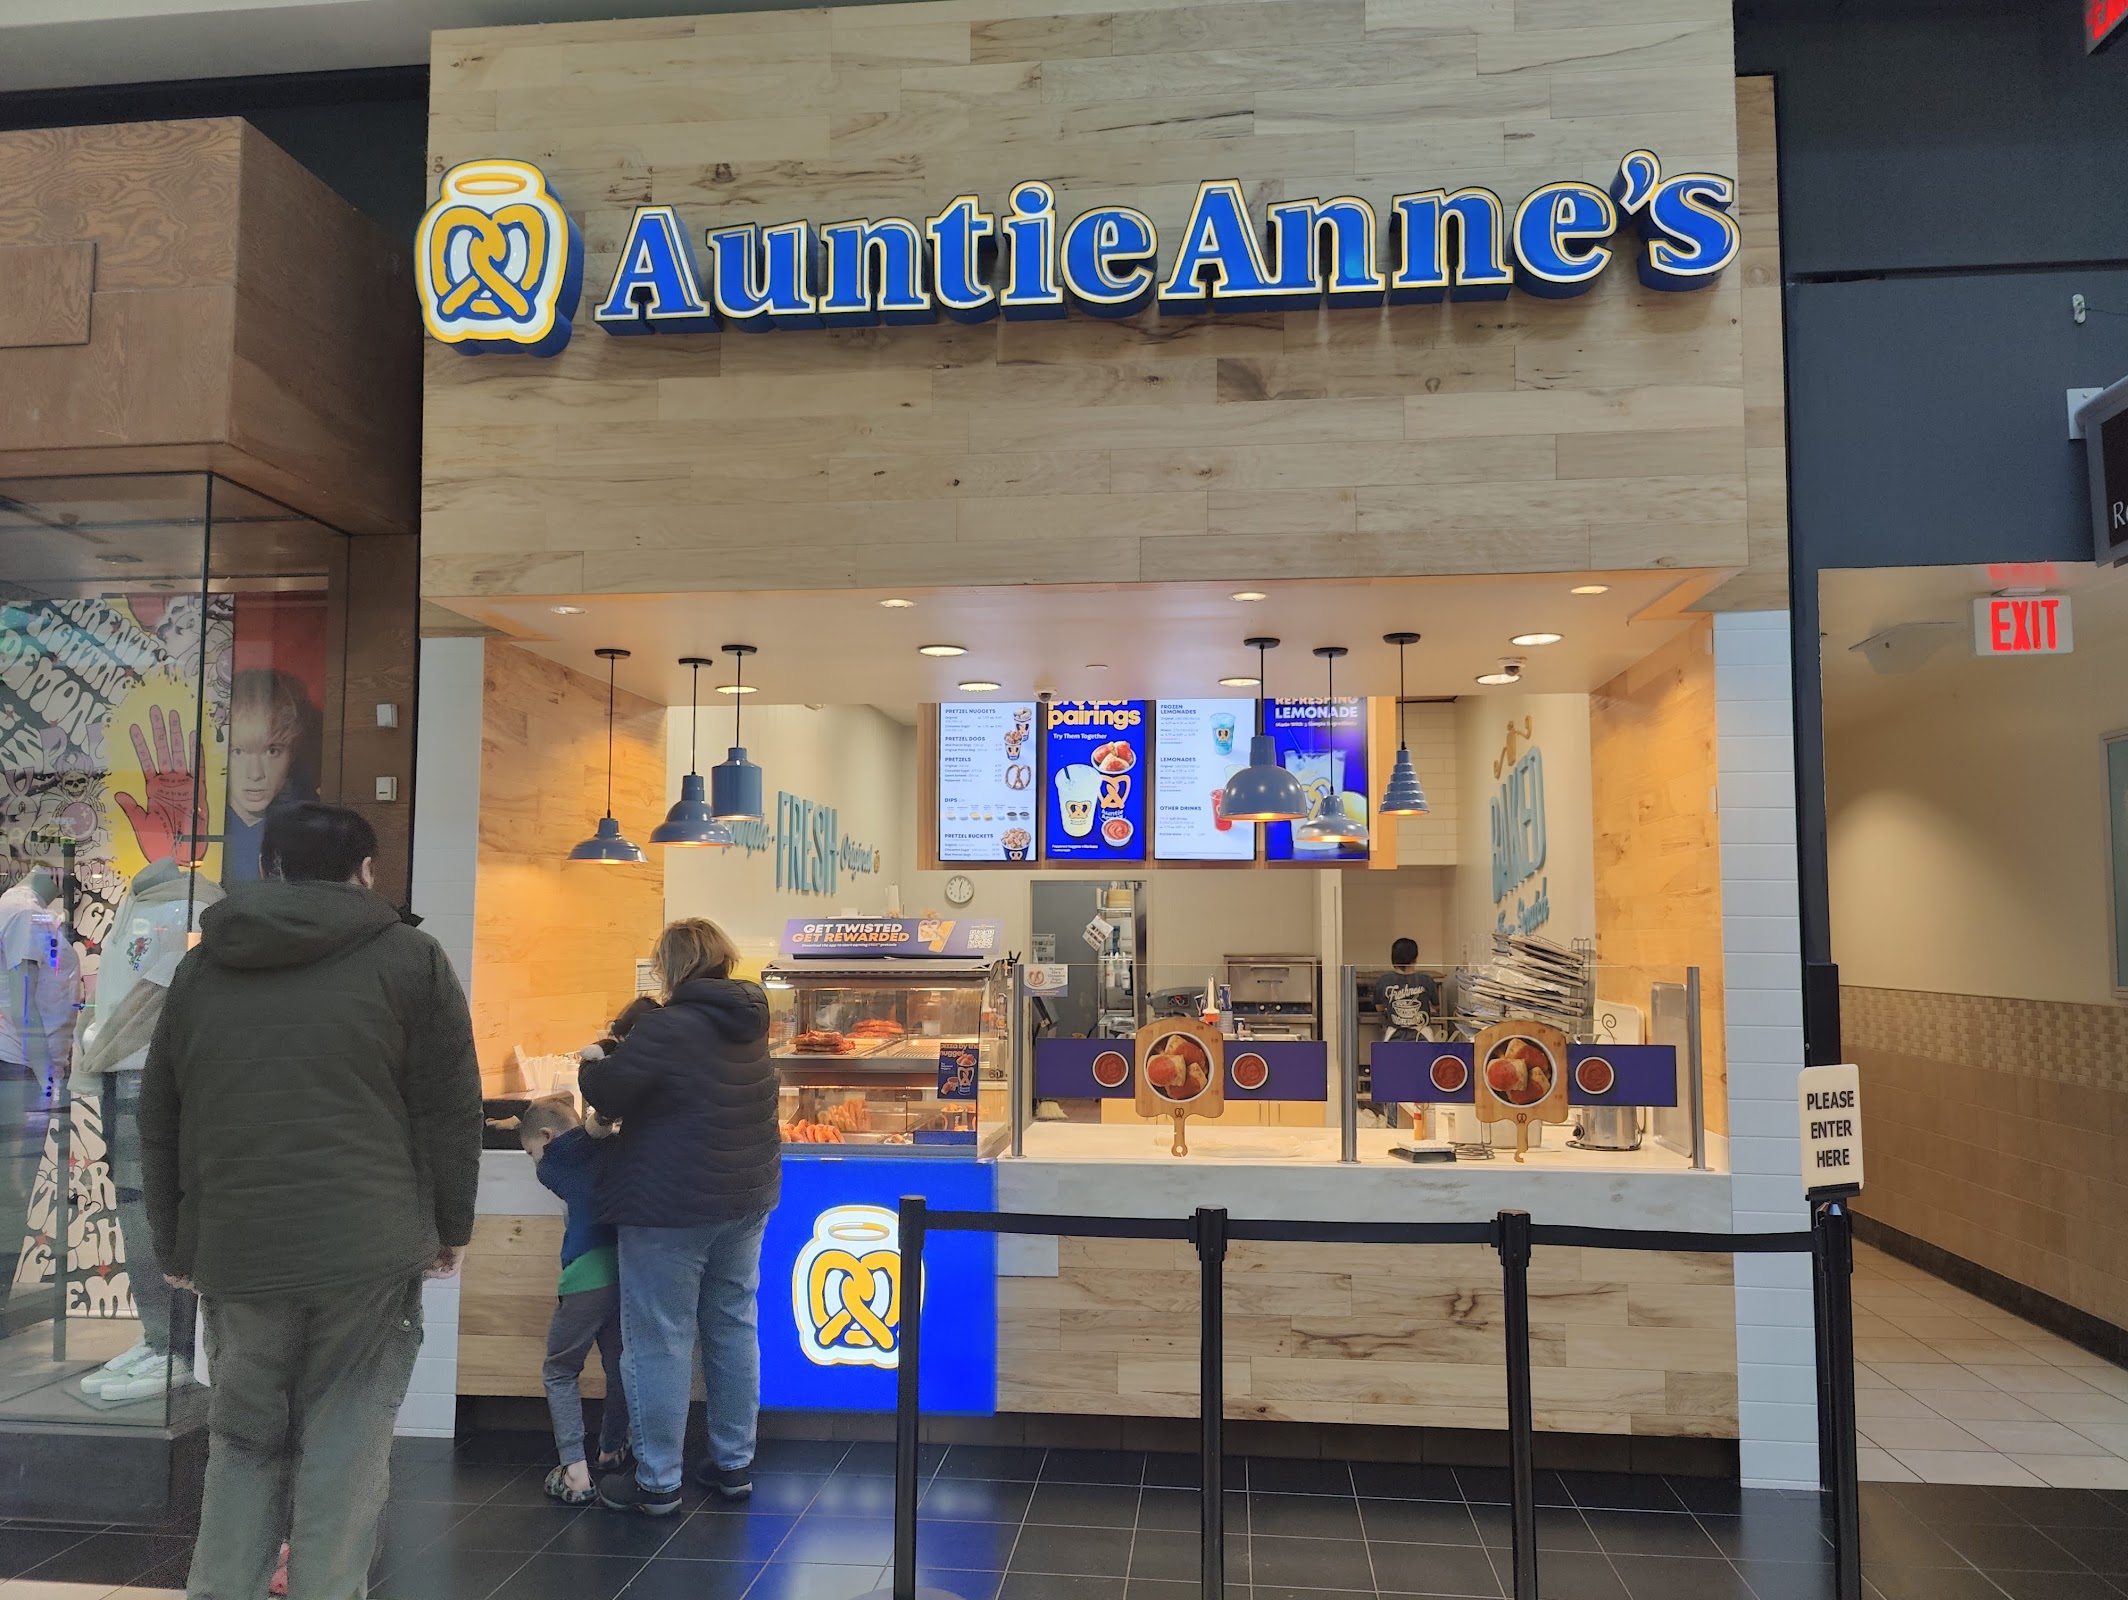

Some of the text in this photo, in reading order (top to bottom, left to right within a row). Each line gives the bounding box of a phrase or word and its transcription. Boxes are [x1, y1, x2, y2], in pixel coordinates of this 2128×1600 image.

[595, 149, 1741, 324] Auntie Anne's
[2113, 501, 2128, 529] R
[1990, 600, 2059, 651] EXIT
[1048, 710, 1141, 730] pairings
[1276, 706, 1358, 718] LEMONADE
[776, 790, 838, 894] FRESH
[792, 933, 910, 942] GET REWARDED
[804, 924, 902, 933] GET TWISTED
[1385, 984, 1425, 1004] Freshness
[1807, 1091, 1854, 1110] PLEASE
[1811, 1120, 1852, 1139] ENTER
[1817, 1149, 1850, 1168] HERE
